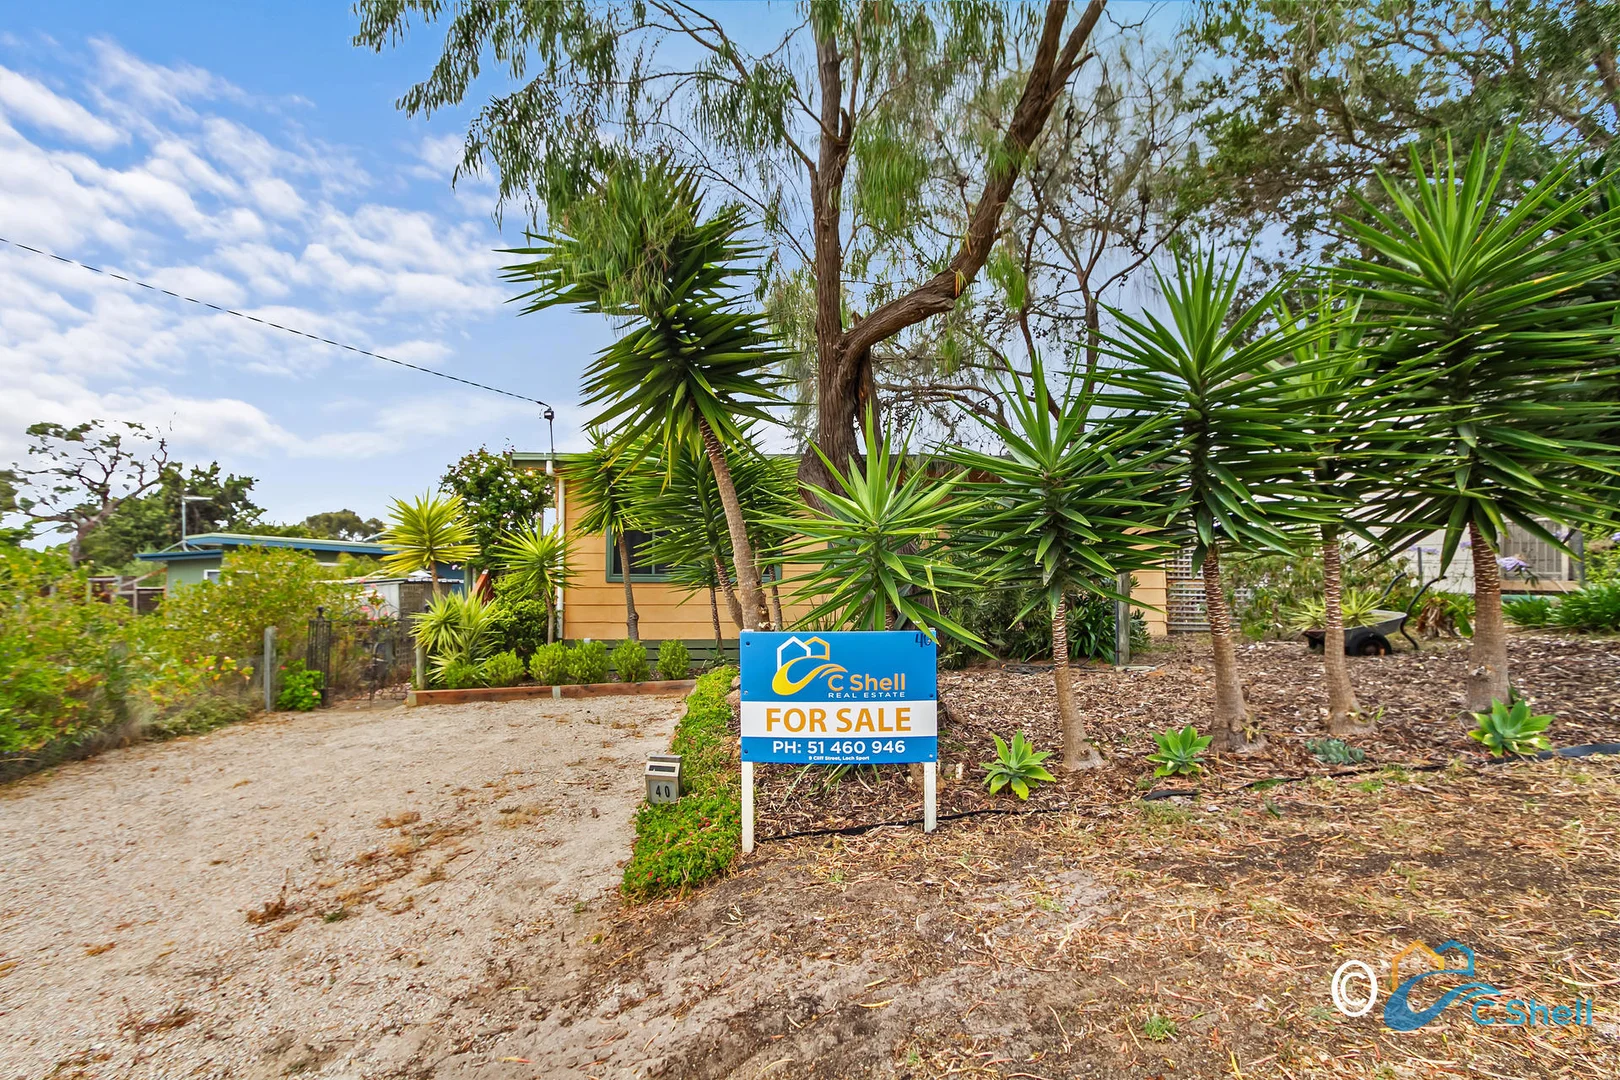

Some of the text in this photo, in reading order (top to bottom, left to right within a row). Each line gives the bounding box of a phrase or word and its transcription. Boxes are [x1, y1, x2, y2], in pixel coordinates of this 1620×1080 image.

[828, 674, 906, 691] C Shell
[766, 707, 911, 732] FOR SALE
[773, 740, 905, 754] PH: 51 460 946
[656, 785, 670, 797] 40
